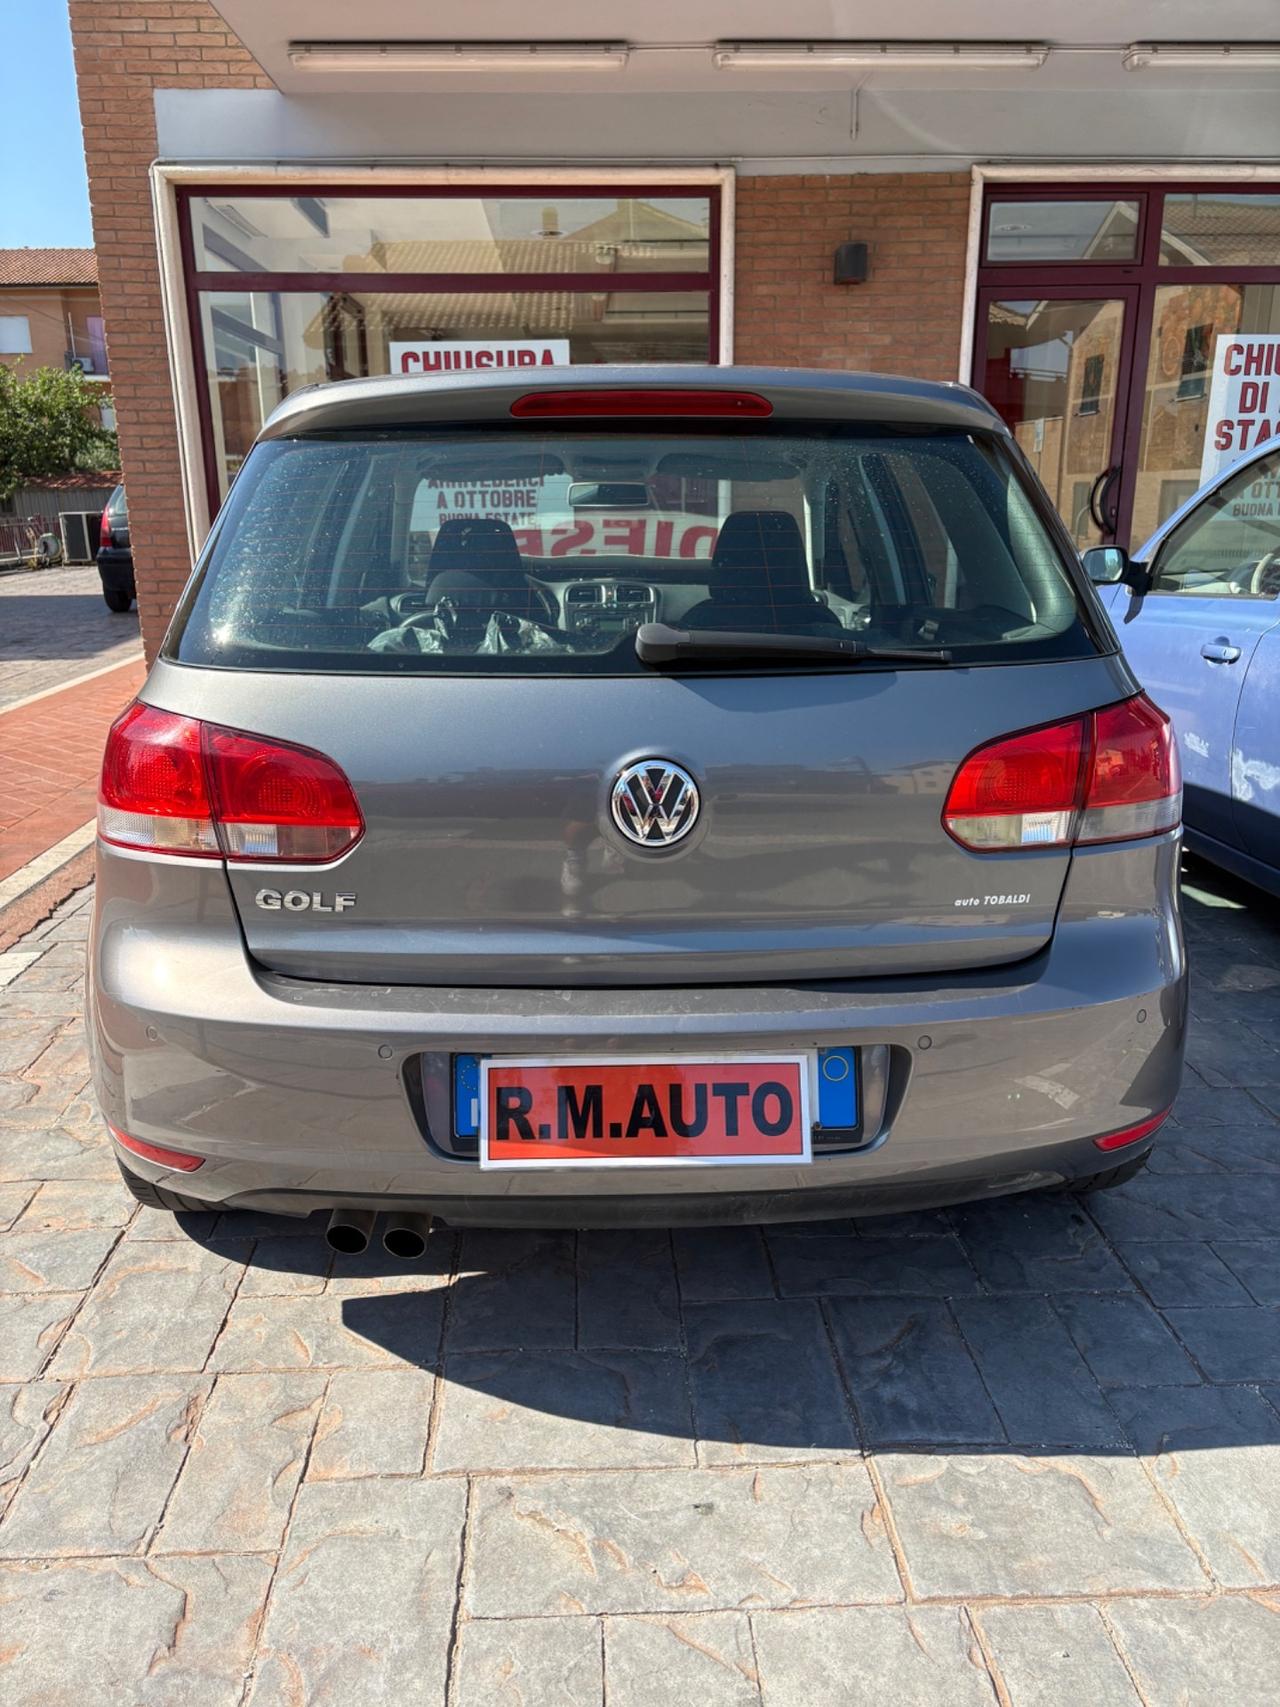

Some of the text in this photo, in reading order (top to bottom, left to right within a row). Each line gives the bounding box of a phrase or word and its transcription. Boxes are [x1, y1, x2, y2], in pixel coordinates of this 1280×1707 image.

[1238, 381, 1270, 414] DI
[437, 489, 538, 509] A OTTOBRE
[1232, 502, 1273, 517] BUONA
[255, 889, 356, 912] GOLF
[954, 893, 1031, 907] auto TOBALDI
[495, 1081, 794, 1140] R.M.AUTO
